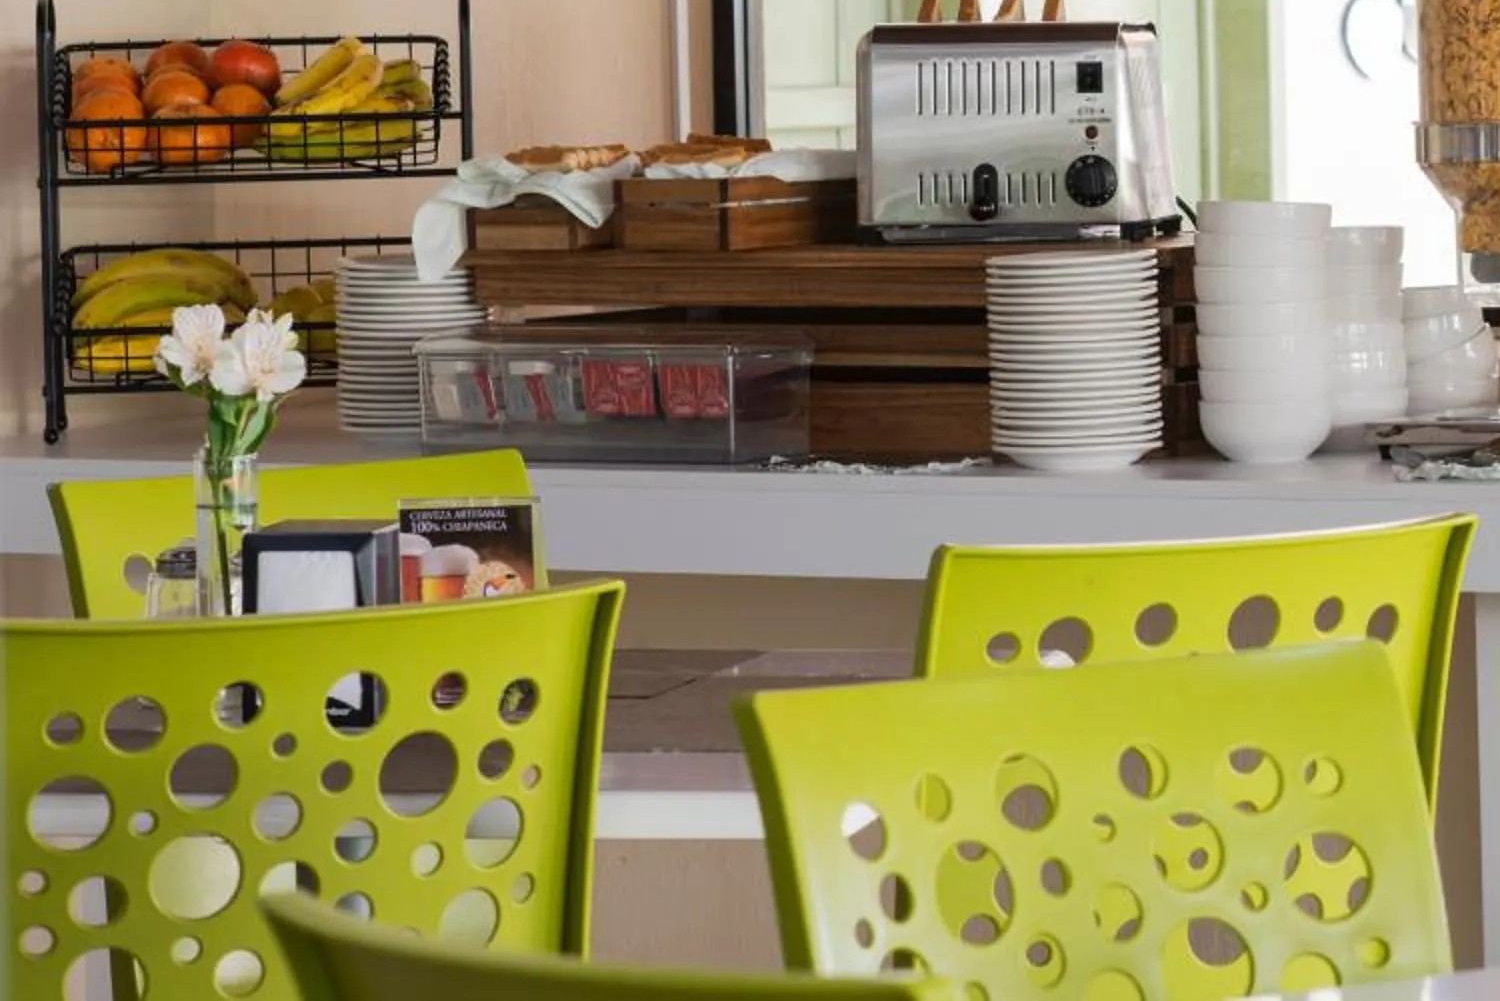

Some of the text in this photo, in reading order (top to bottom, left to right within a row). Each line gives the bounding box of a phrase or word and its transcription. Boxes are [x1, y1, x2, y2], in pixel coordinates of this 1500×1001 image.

[409, 508, 508, 520] CERVEZA ARTESANAL
[411, 519, 507, 534] 100% CHIAPANECA
